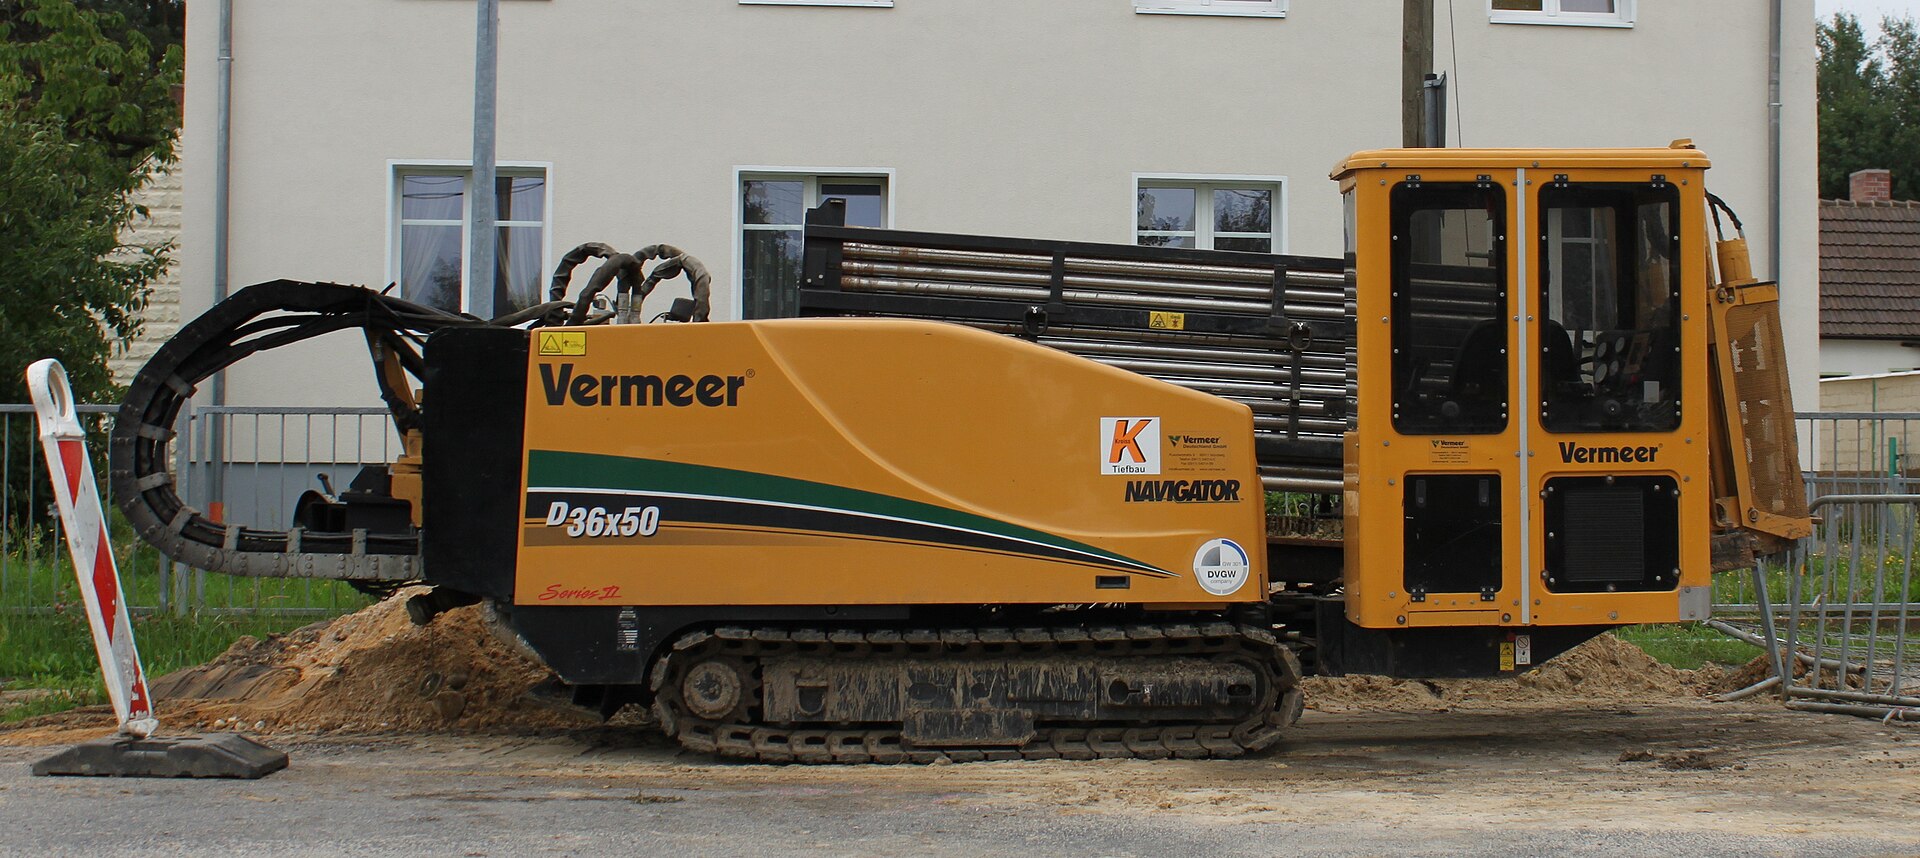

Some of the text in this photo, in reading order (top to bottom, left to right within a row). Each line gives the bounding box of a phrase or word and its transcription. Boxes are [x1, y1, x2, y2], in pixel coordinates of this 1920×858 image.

[1109, 419, 1152, 463] K
[1182, 435, 1220, 444] Vermeer
[1558, 441, 1659, 464] Vermeer
[1112, 465, 1146, 473] Tiefbau
[1125, 480, 1240, 503] NAVIGATOR
[546, 501, 660, 538] D36x50
[1207, 570, 1237, 578] DVGW
[538, 584, 623, 601] Series II
